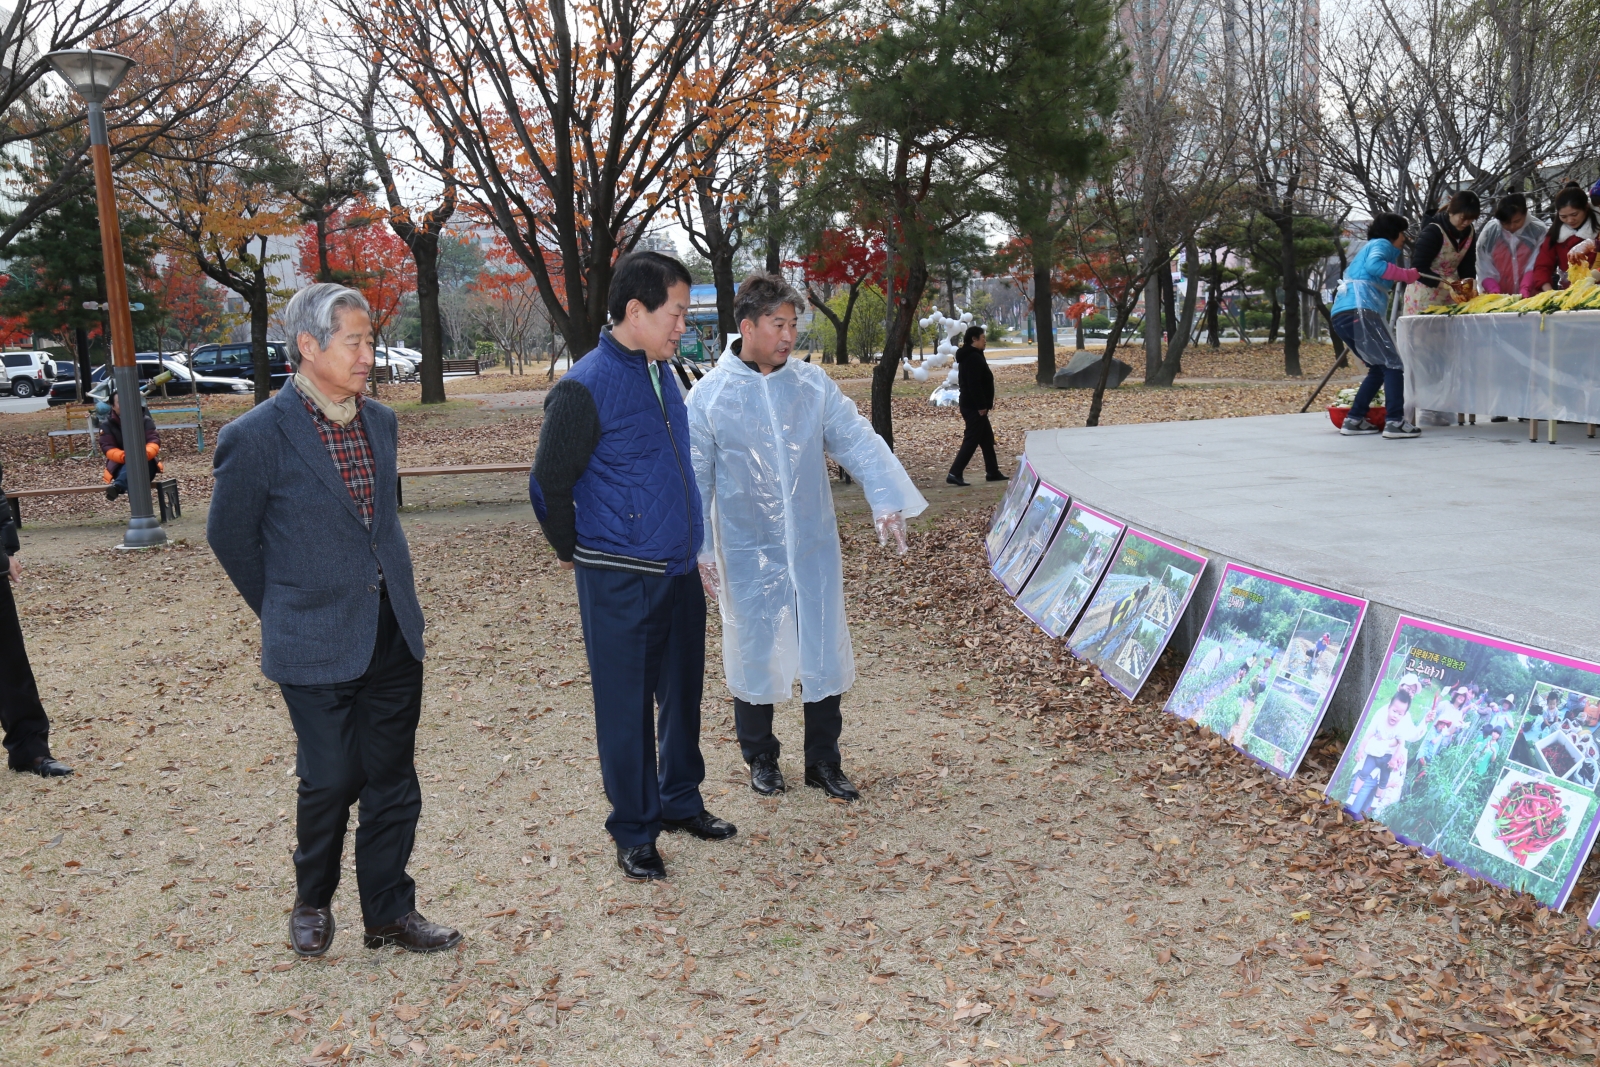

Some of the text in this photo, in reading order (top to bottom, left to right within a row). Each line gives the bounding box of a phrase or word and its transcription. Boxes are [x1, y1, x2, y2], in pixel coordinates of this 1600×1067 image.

[1405, 659, 1445, 680] 고추따기
[1410, 647, 1466, 671] 다문화가족 주말농장
